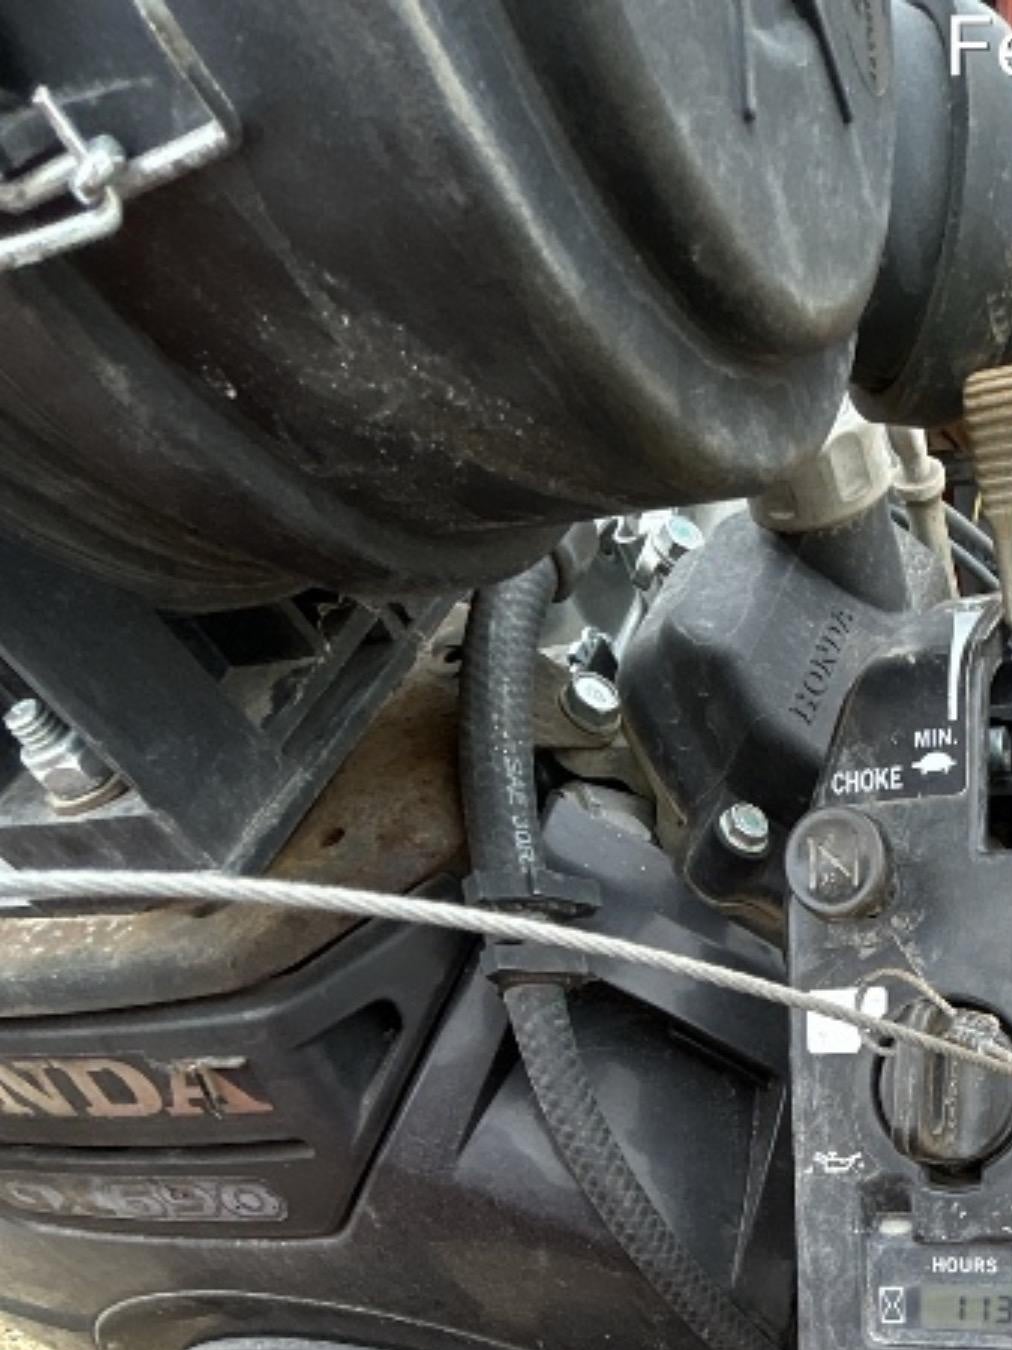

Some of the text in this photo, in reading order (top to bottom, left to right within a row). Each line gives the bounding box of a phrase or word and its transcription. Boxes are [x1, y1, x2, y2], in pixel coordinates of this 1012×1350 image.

[914, 728, 958, 748] MIN.
[830, 765, 904, 795] CHOKE
[932, 1256, 998, 1273] HOURS
